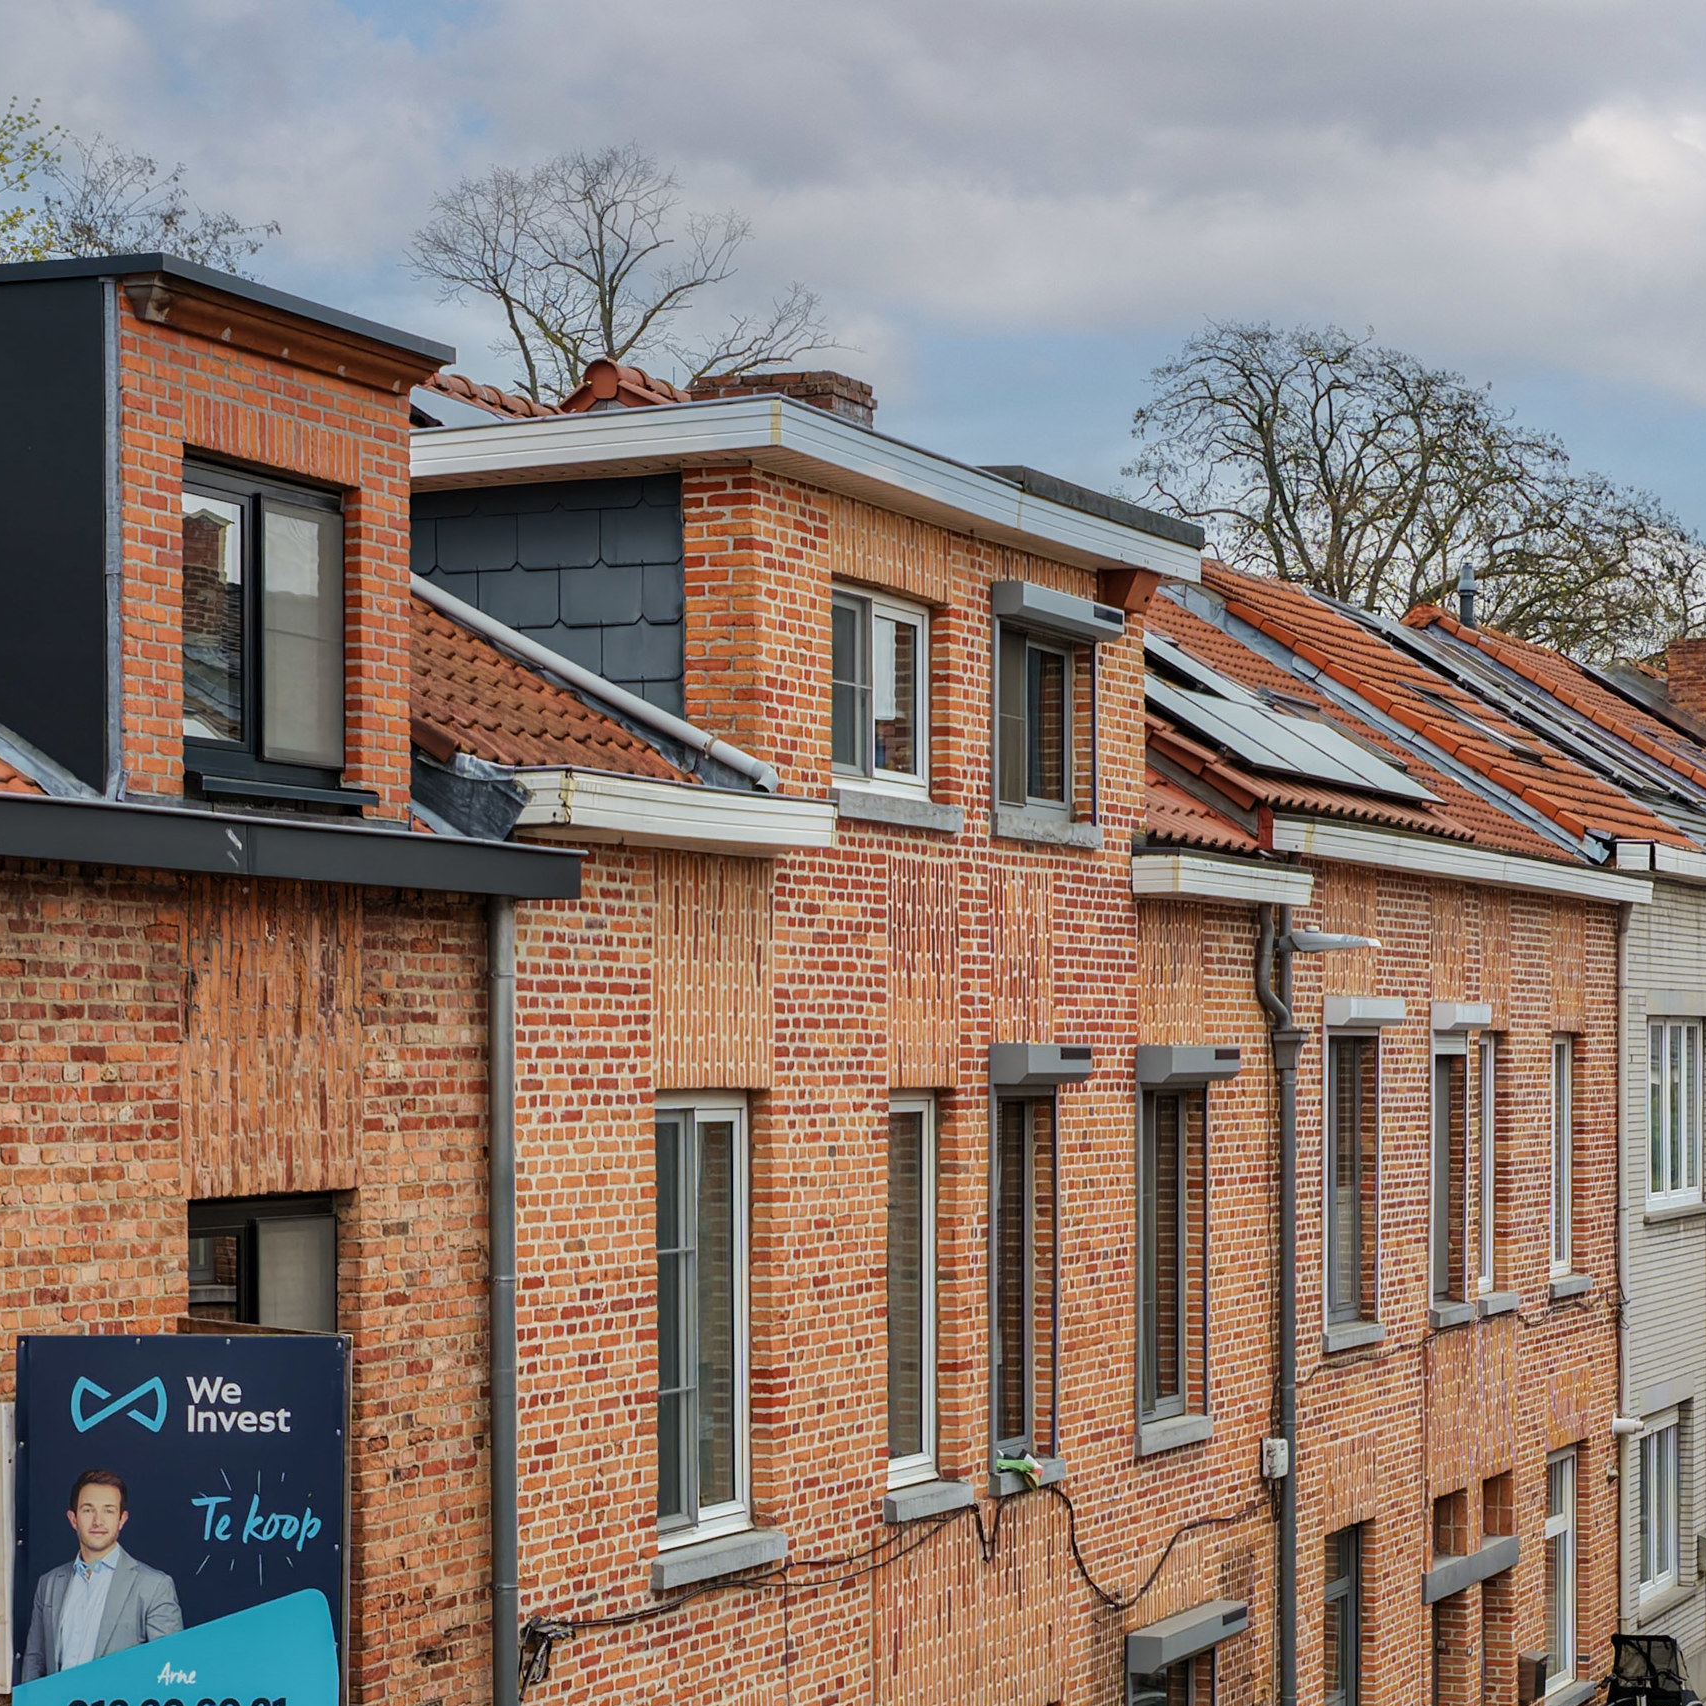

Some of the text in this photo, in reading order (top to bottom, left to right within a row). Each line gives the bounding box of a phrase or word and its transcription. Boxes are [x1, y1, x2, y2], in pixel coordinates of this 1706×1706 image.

[186, 1376, 242, 1404] We
[187, 1405, 291, 1433] Invest
[191, 1494, 322, 1551] Te koop
[157, 1662, 197, 1686] Arne
